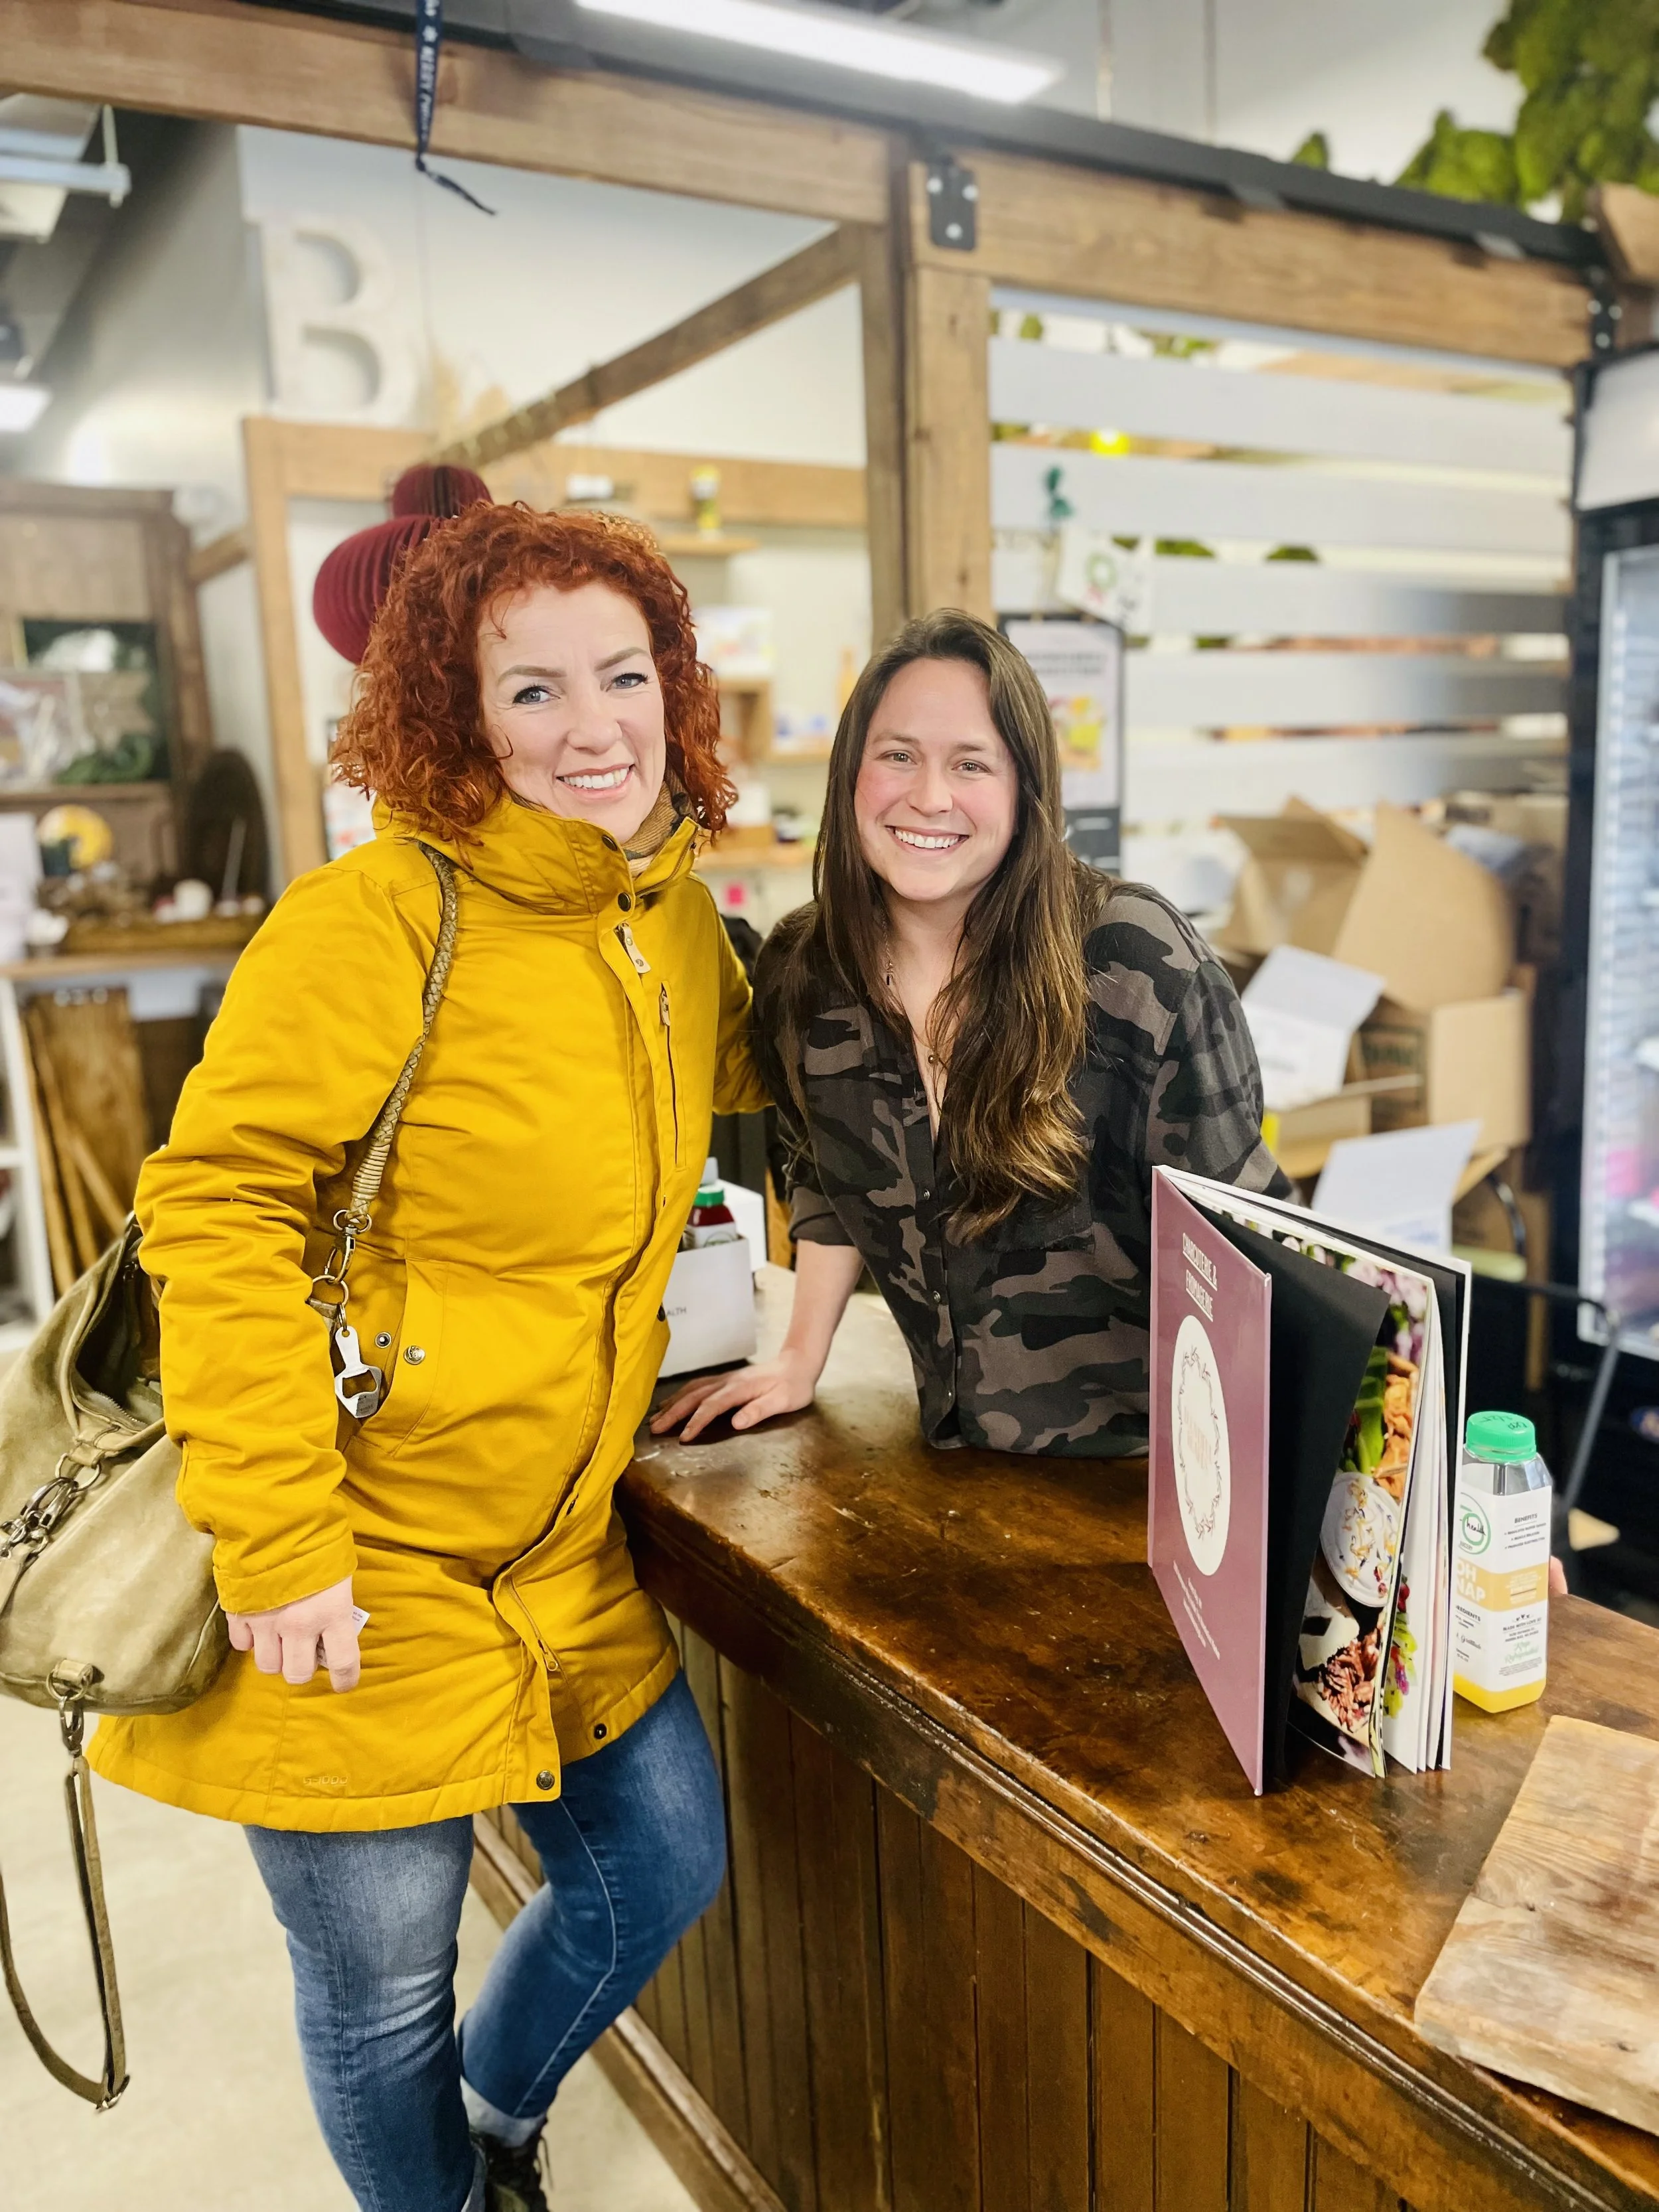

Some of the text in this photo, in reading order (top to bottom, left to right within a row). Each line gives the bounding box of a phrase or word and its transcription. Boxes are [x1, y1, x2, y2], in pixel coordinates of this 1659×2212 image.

[244, 214, 418, 426] B
[1183, 1232, 1218, 1287] CHARCUTERIE &
[1186, 1268, 1214, 1317] FROMAGERIE
[1467, 1516, 1486, 1536] health
[1514, 1513, 1538, 1524] BENEFITS
[1457, 1560, 1477, 1583] OH
[1457, 1577, 1486, 1602] NAP
